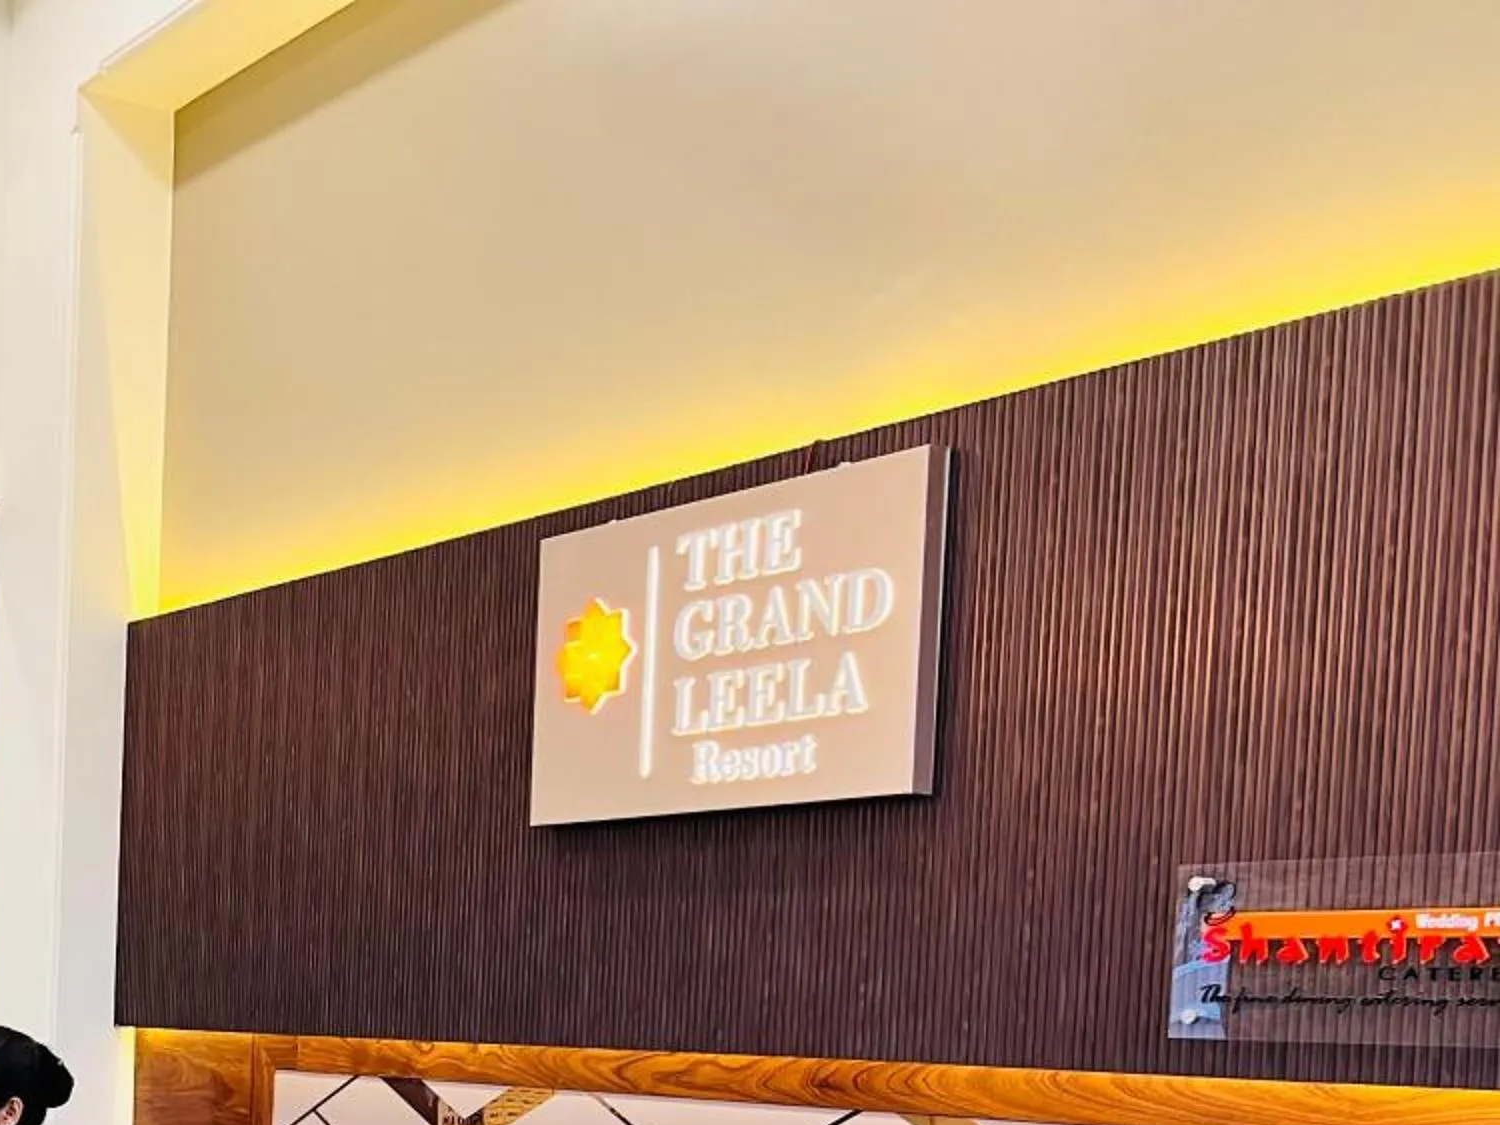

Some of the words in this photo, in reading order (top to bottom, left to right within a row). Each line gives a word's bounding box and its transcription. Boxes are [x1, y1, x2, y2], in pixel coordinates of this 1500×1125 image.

[675, 508, 802, 591] THE
[673, 567, 895, 661] GRAND
[671, 651, 870, 735] LEELA
[692, 734, 818, 785] Resort
[1202, 916, 1500, 965] Shantira
